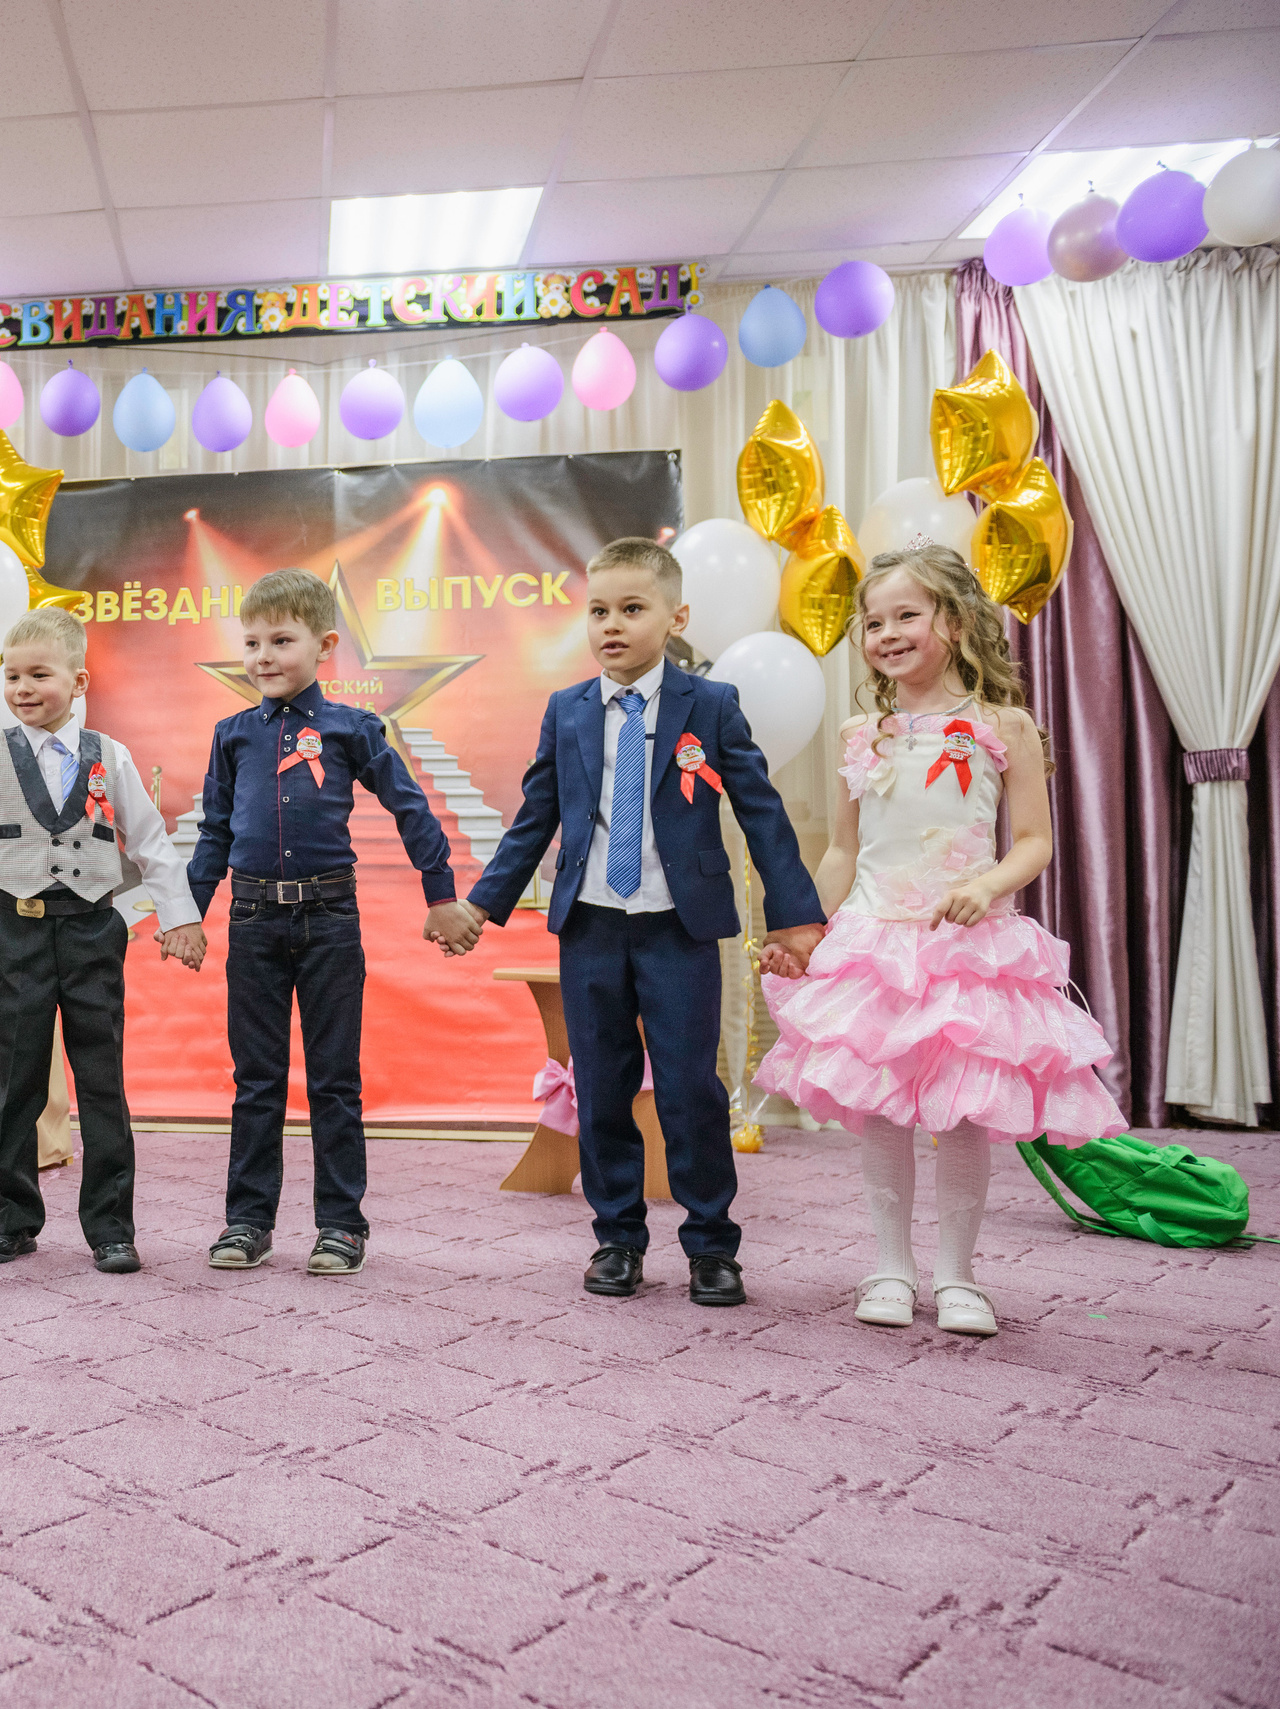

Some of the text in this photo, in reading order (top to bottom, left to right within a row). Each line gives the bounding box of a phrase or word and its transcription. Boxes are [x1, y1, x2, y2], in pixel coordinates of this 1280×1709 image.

[286, 272, 541, 329] ДЕТСКИЙ
[72, 570, 572, 626] ЗВЁЗДН ВЫПУСК
